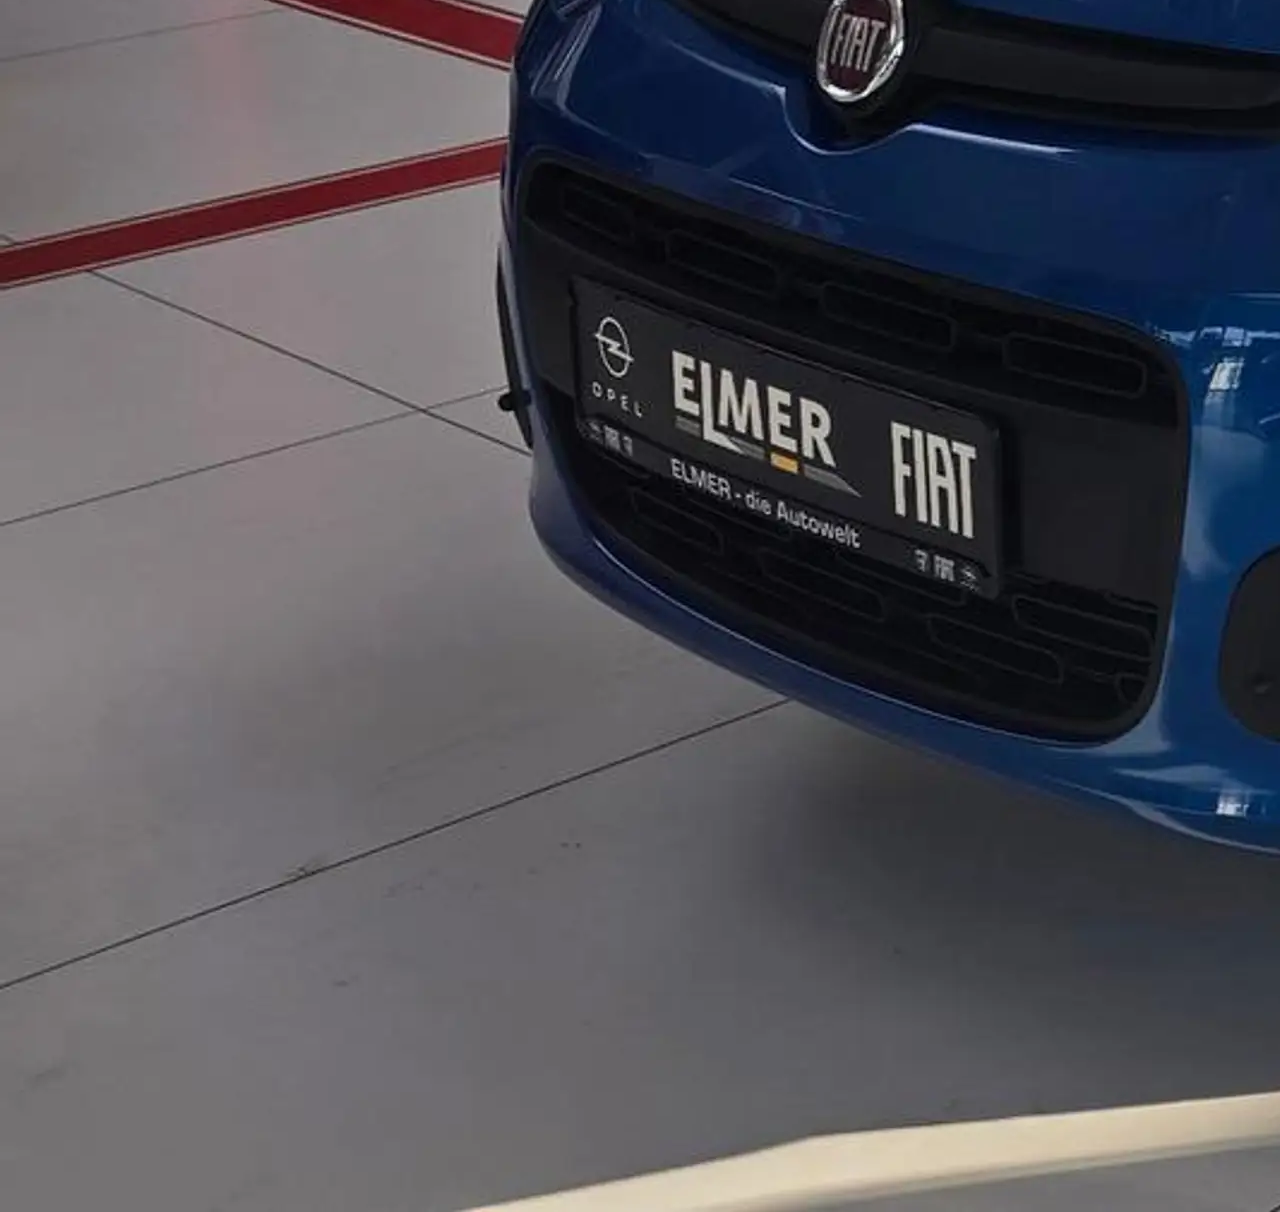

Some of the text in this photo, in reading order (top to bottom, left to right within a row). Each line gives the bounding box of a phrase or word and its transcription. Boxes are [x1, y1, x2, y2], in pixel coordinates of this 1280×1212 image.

[830, 12, 889, 74] FIAT
[592, 380, 643, 419] OPEL
[672, 349, 836, 469] ELMER
[670, 457, 732, 501] ELMER
[744, 489, 772, 517] die
[776, 500, 862, 549] Autowelt
[890, 420, 978, 540] FIAT
